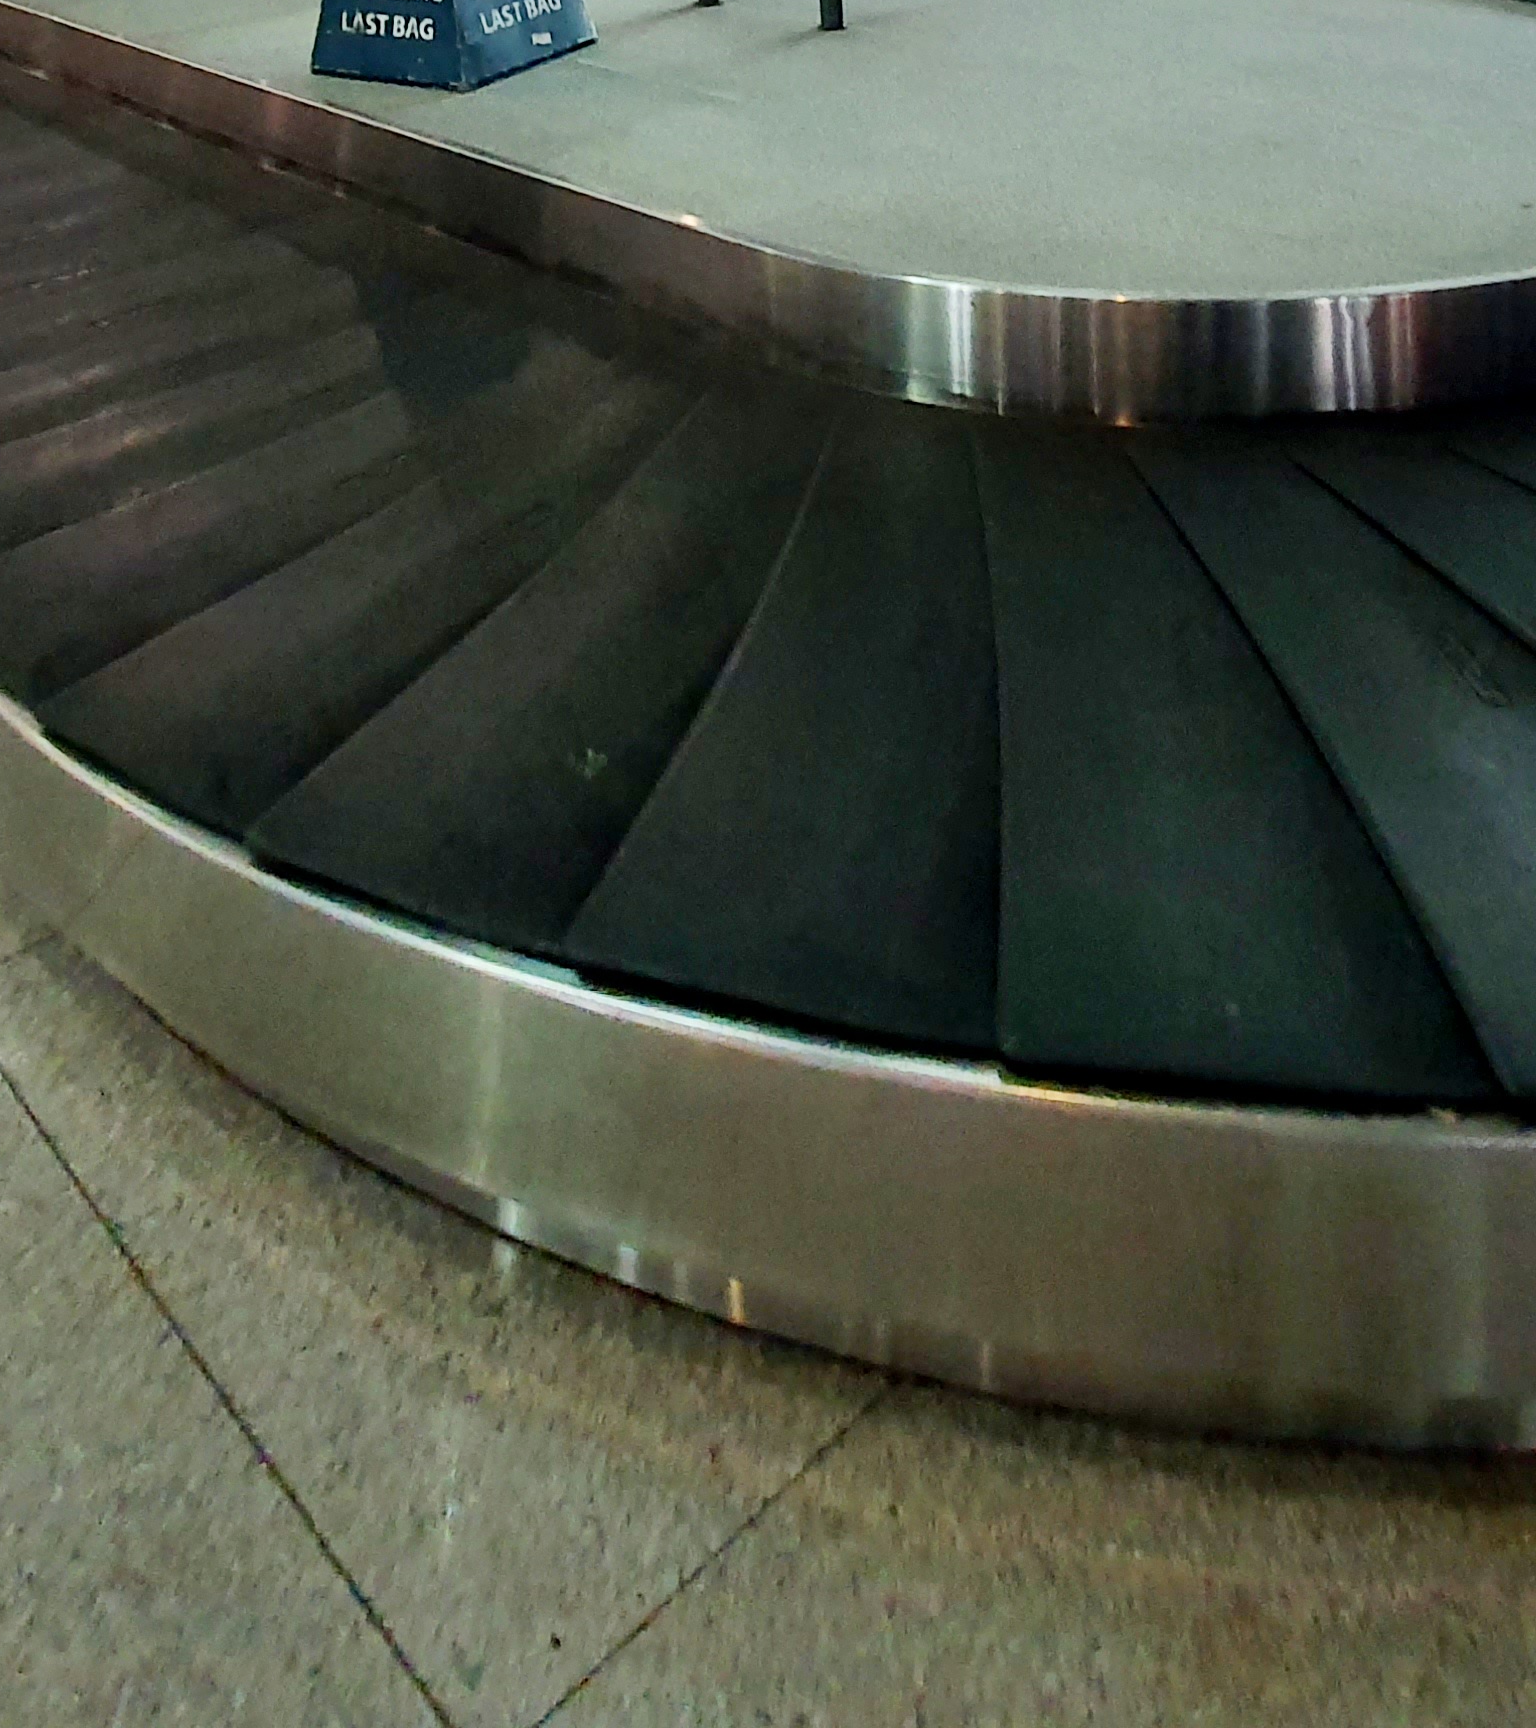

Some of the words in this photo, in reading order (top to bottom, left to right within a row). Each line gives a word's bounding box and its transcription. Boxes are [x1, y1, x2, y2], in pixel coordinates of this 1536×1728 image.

[341, 10, 390, 37] LAST
[392, 15, 435, 41] BAG
[479, 3, 522, 35] LAST
